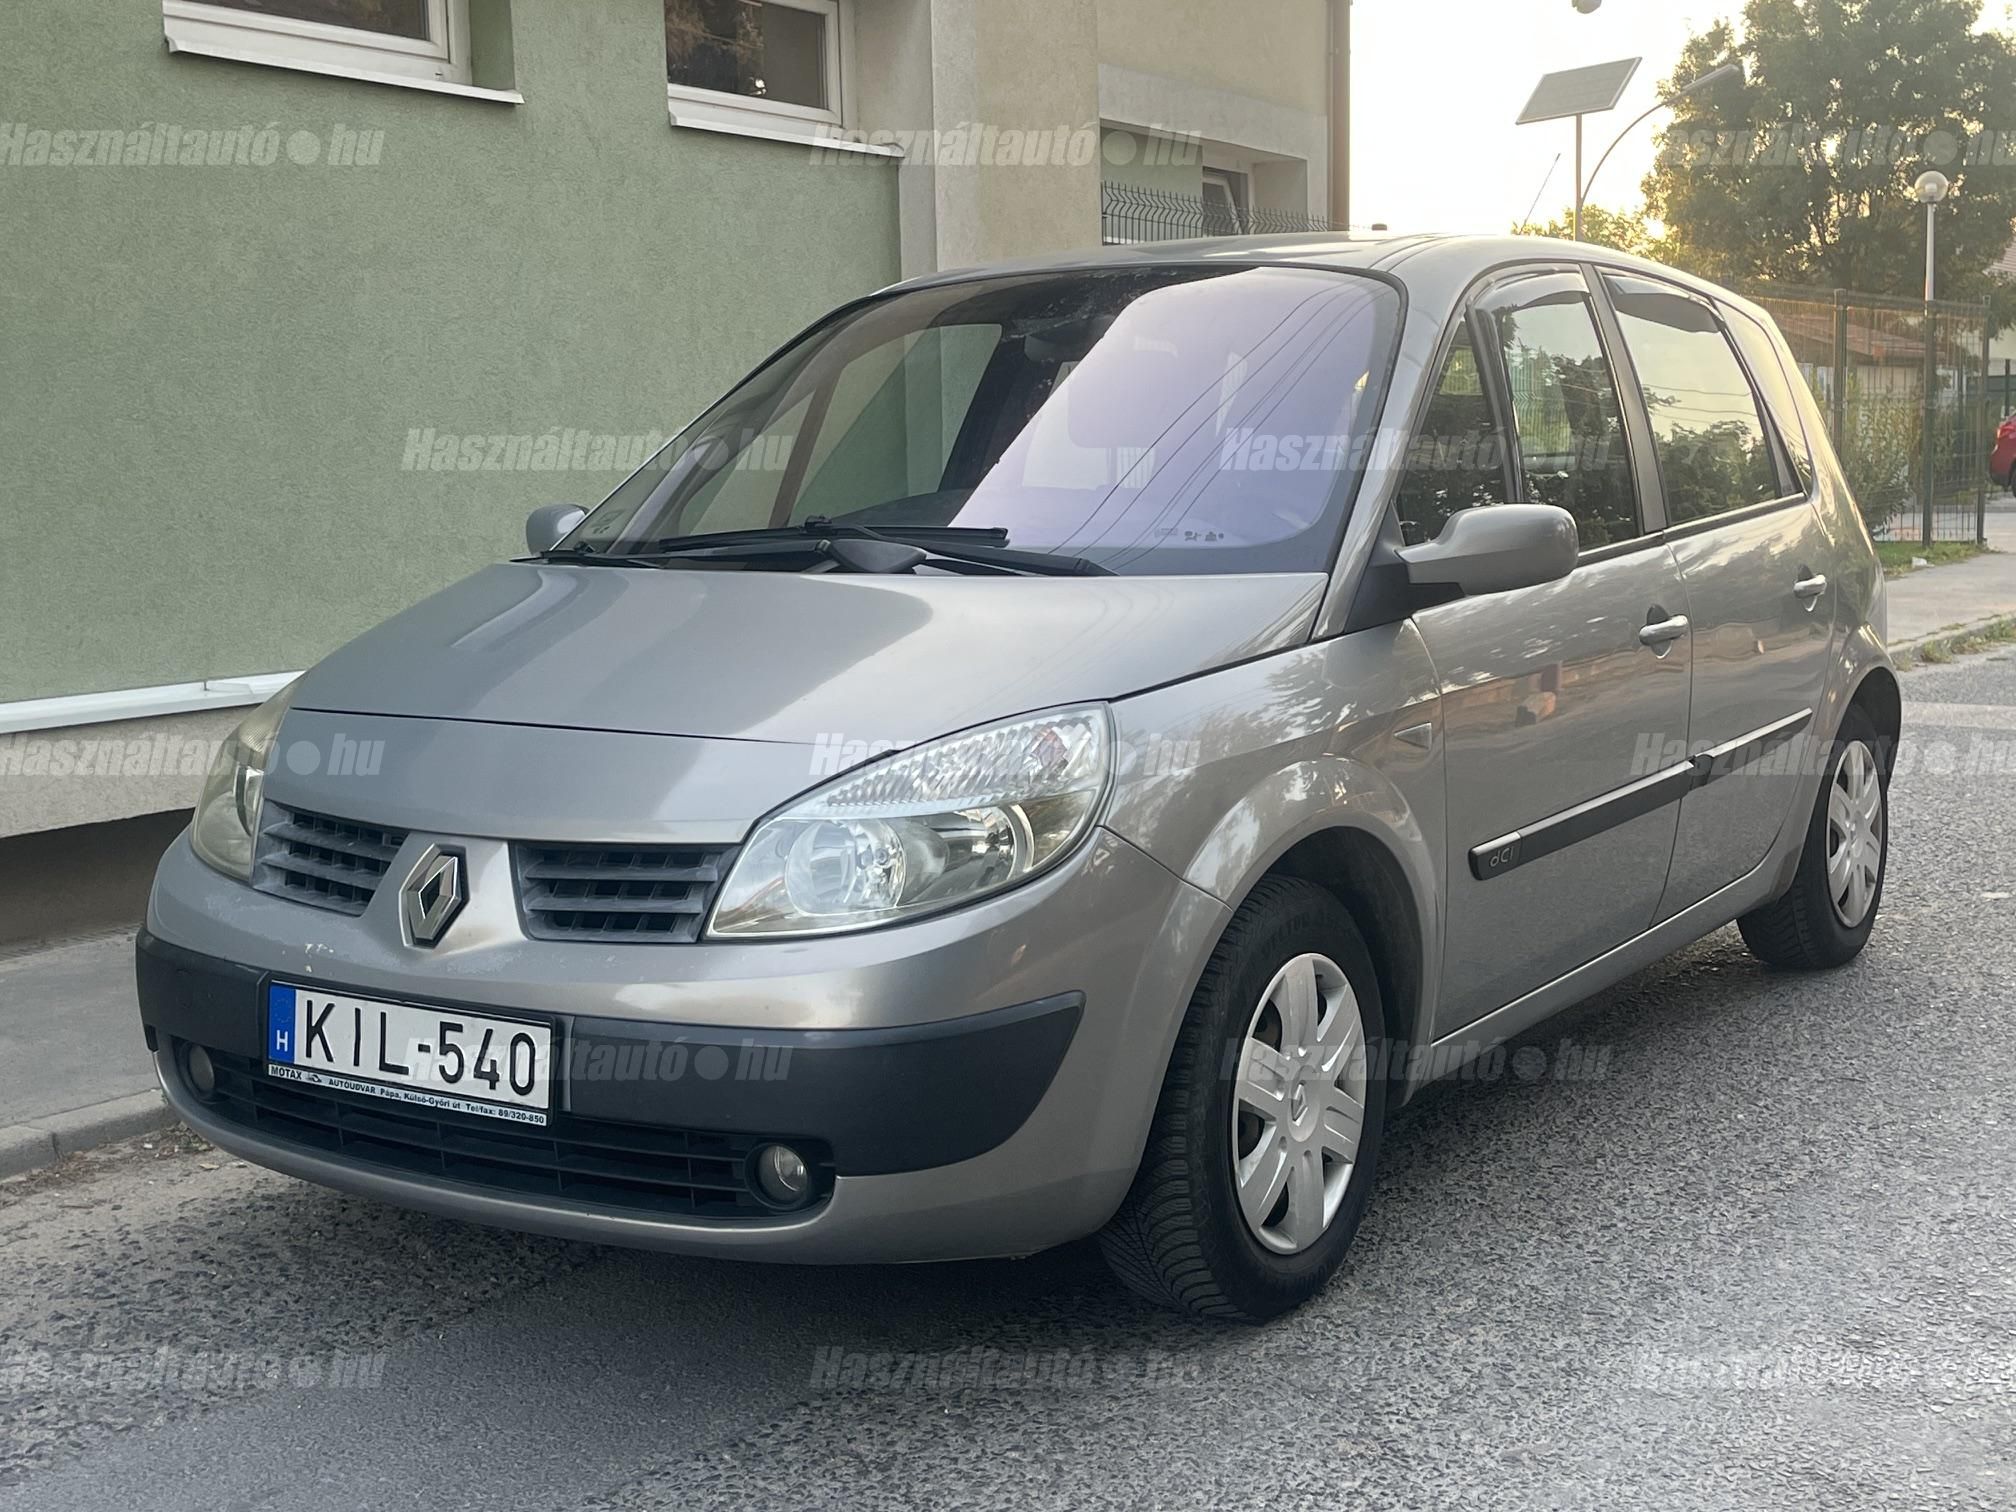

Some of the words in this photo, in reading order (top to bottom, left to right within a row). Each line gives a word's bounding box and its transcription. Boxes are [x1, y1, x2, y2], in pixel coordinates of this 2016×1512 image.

[276, 1030, 289, 1053] H
[304, 999, 537, 1097] KIL-540
[270, 1066, 303, 1081] MOTAX
[498, 1108, 545, 1125] 89/320-850
